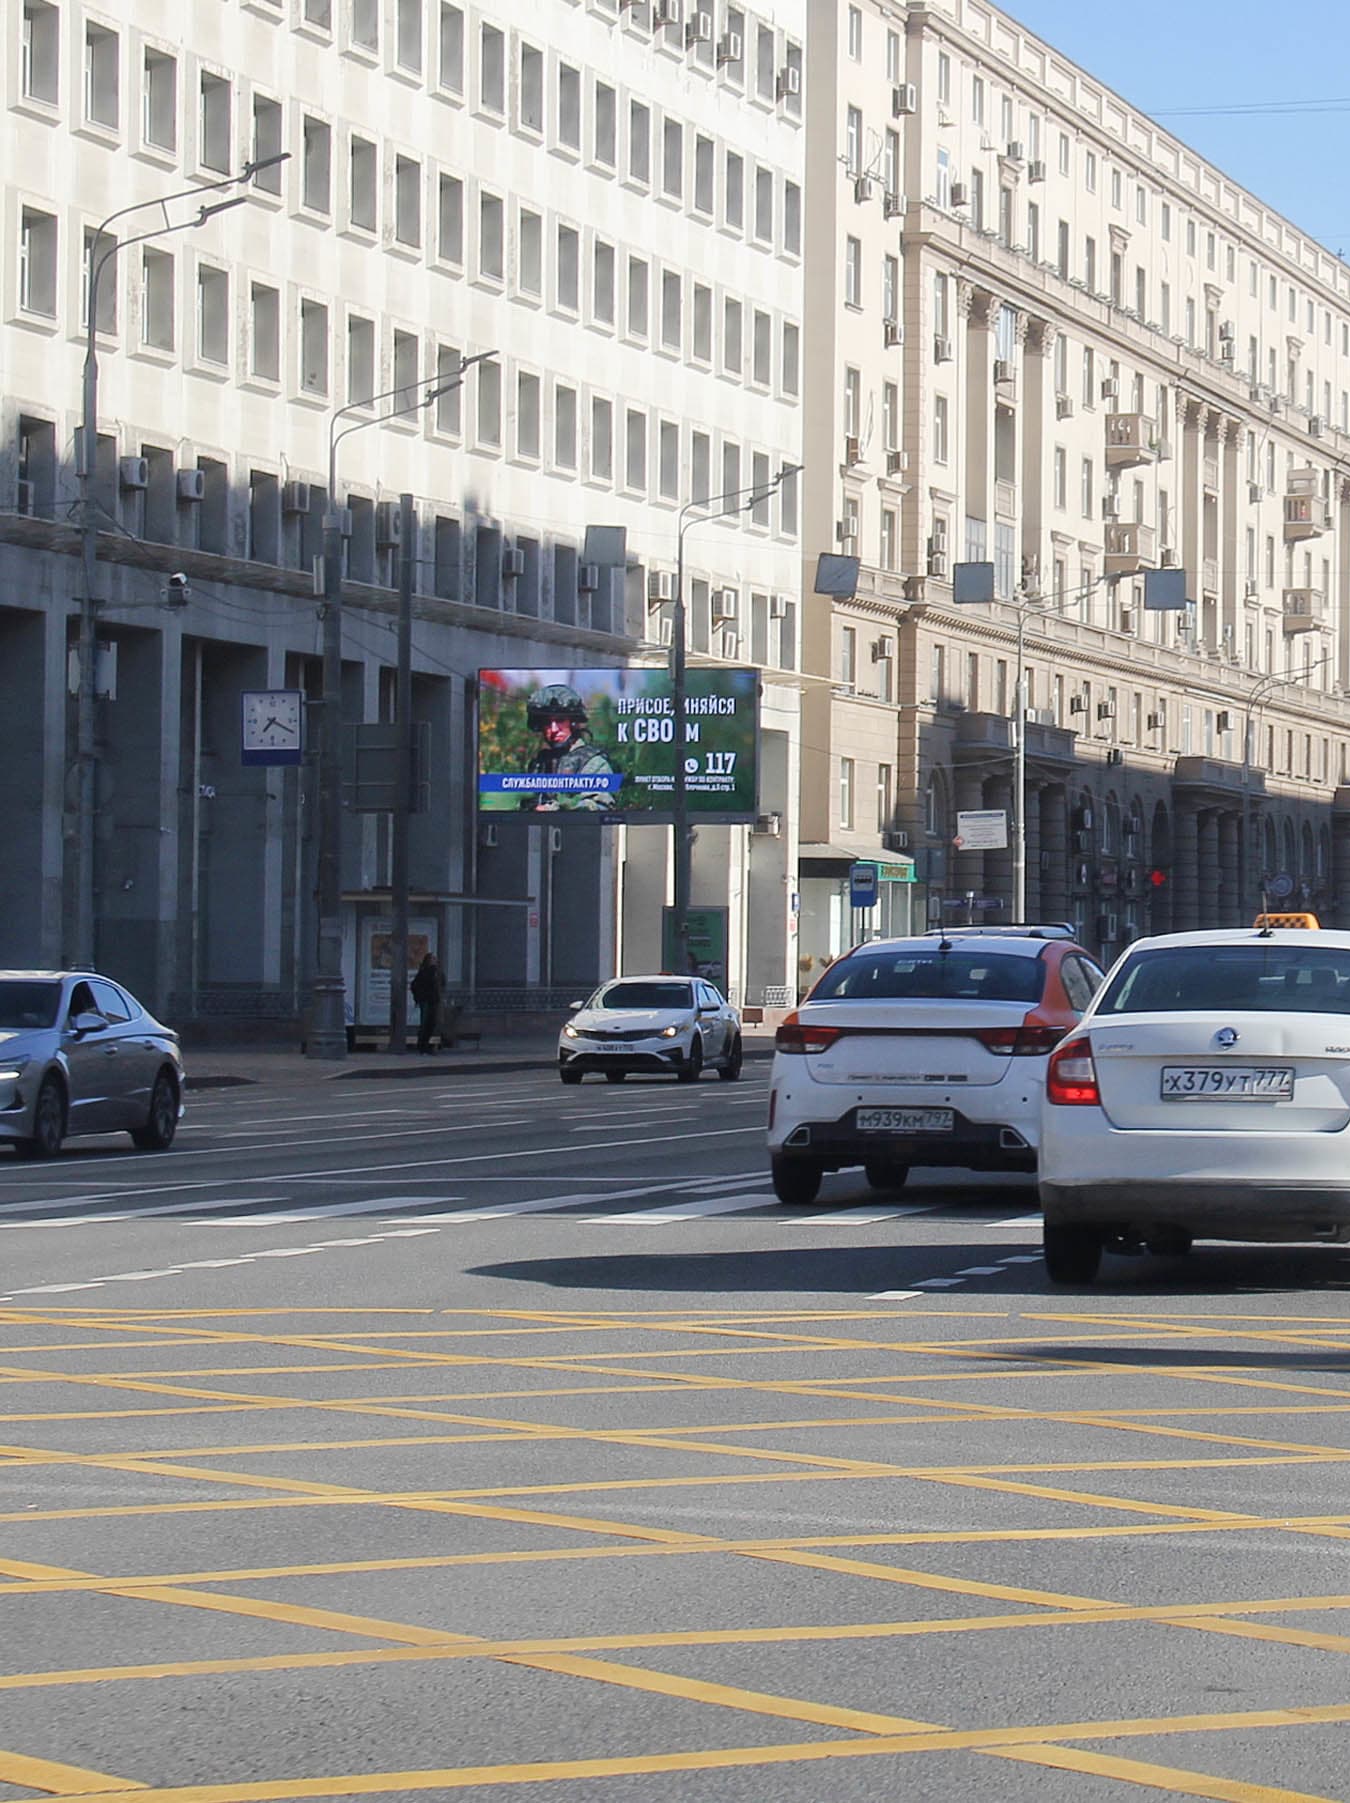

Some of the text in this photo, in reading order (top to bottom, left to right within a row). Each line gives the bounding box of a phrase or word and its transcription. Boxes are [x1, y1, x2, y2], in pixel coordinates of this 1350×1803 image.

[618, 718, 699, 742] К СВОМ
[705, 752, 736, 774] 117
[502, 777, 609, 788] СЛУЖБАПОКОНТРАКТУ.РФ
[1256, 1070, 1288, 1086] 777
